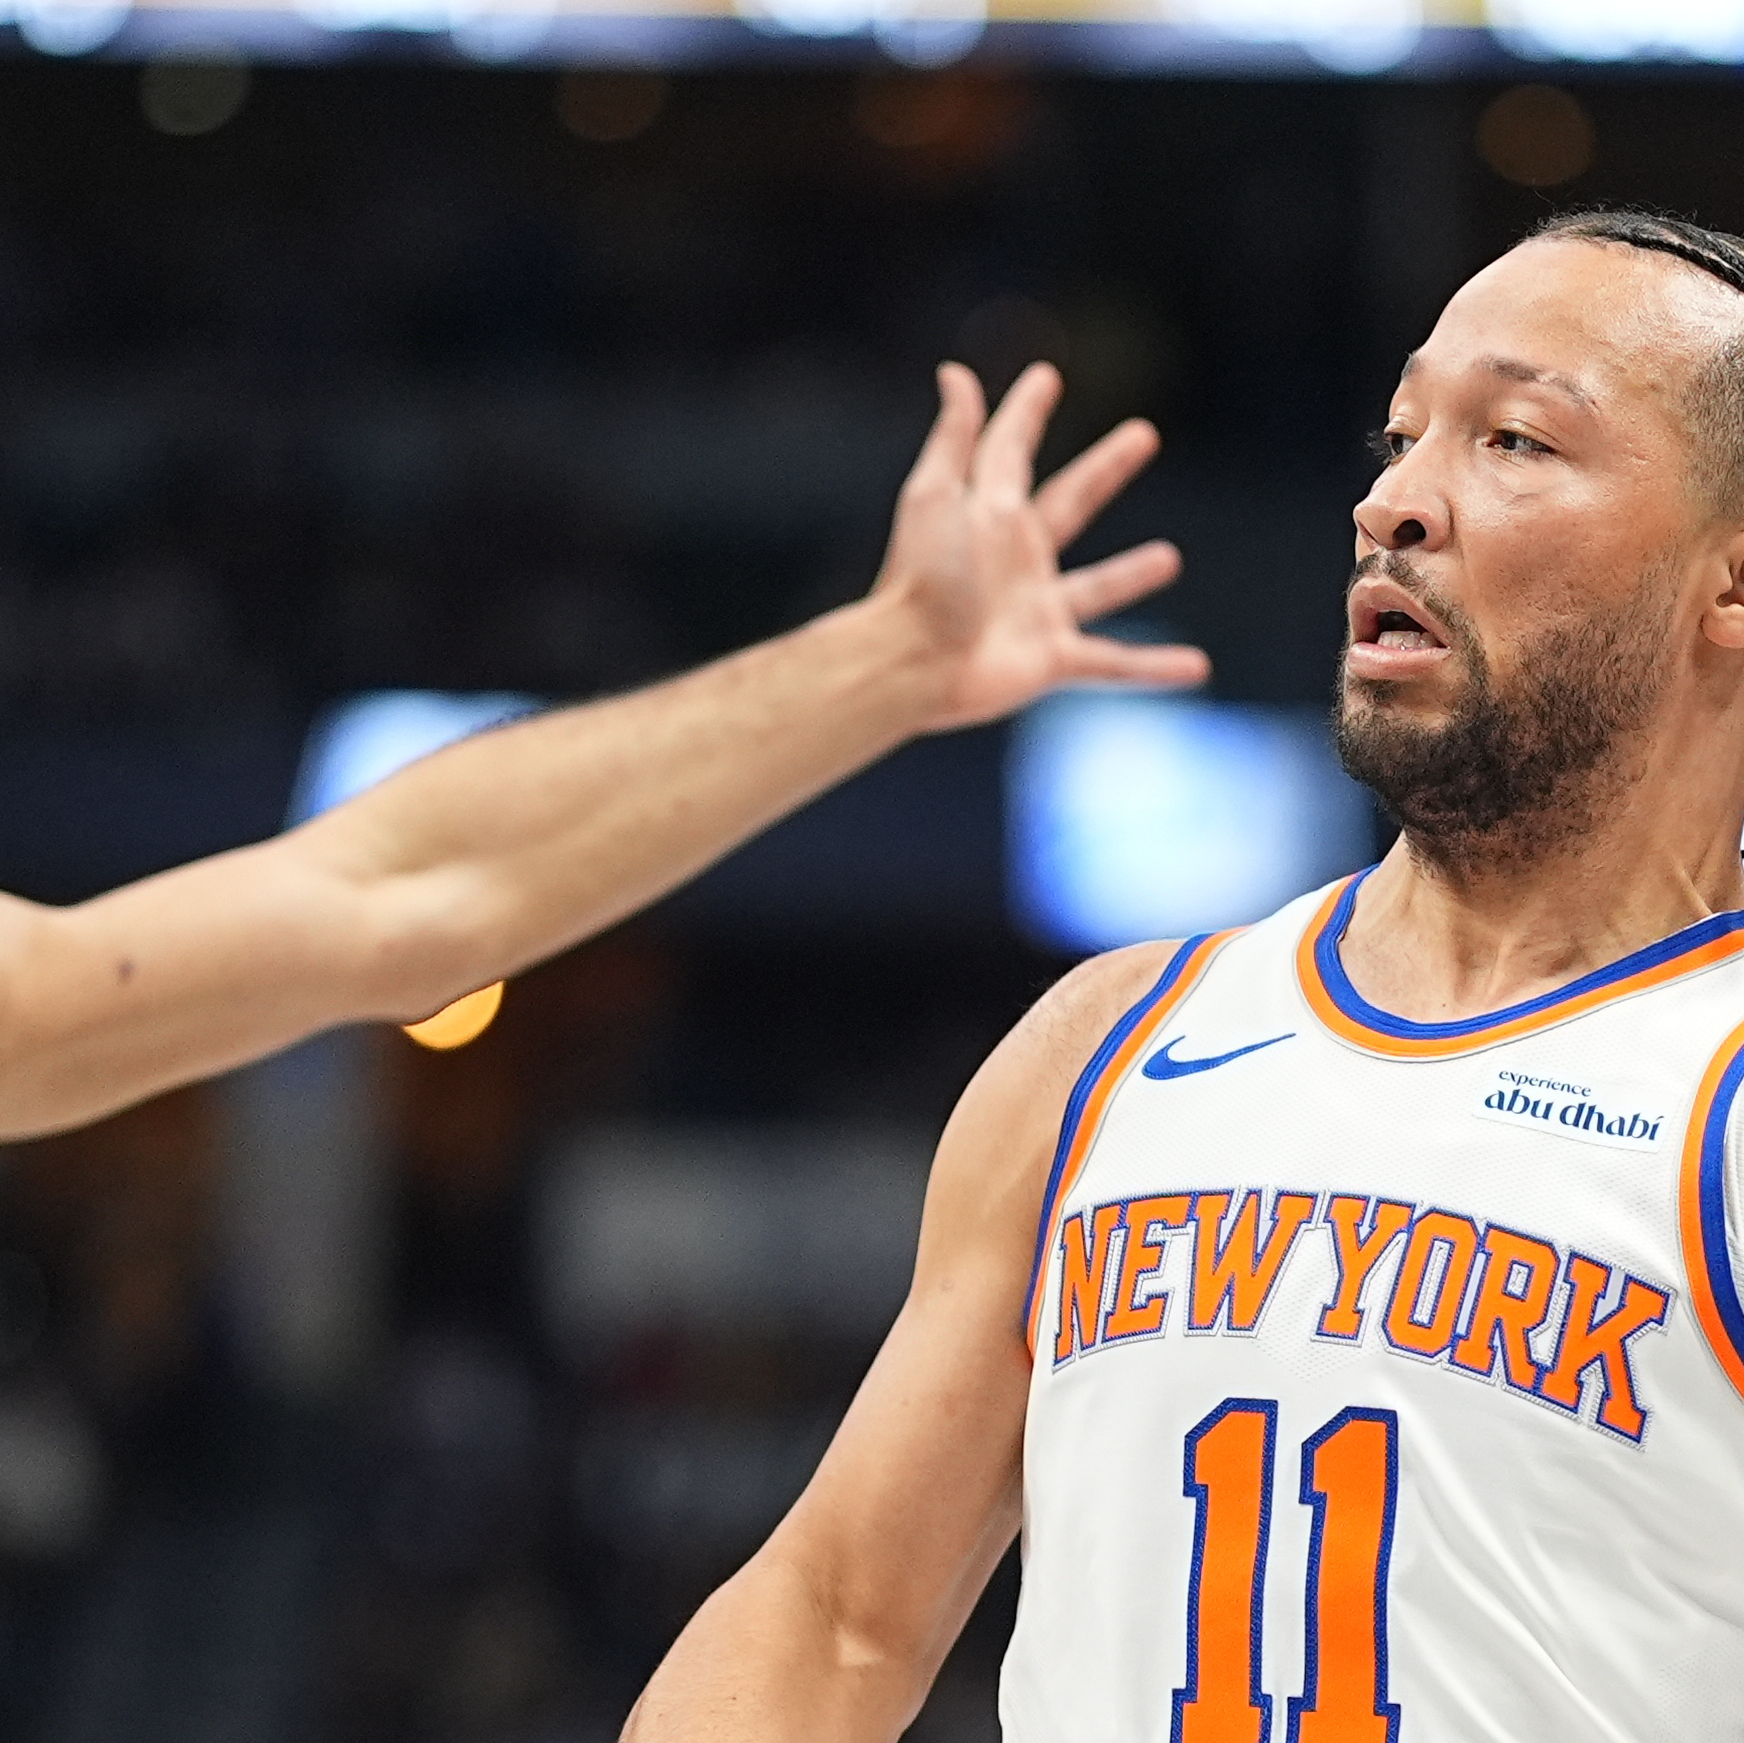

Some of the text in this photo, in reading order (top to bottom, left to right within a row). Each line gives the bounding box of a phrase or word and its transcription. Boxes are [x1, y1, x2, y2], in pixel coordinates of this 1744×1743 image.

[1498, 1069, 1592, 1098] experience
[1484, 1088, 1665, 1141] abu dhabi
[1052, 1184, 1673, 1452] NEW YORK
